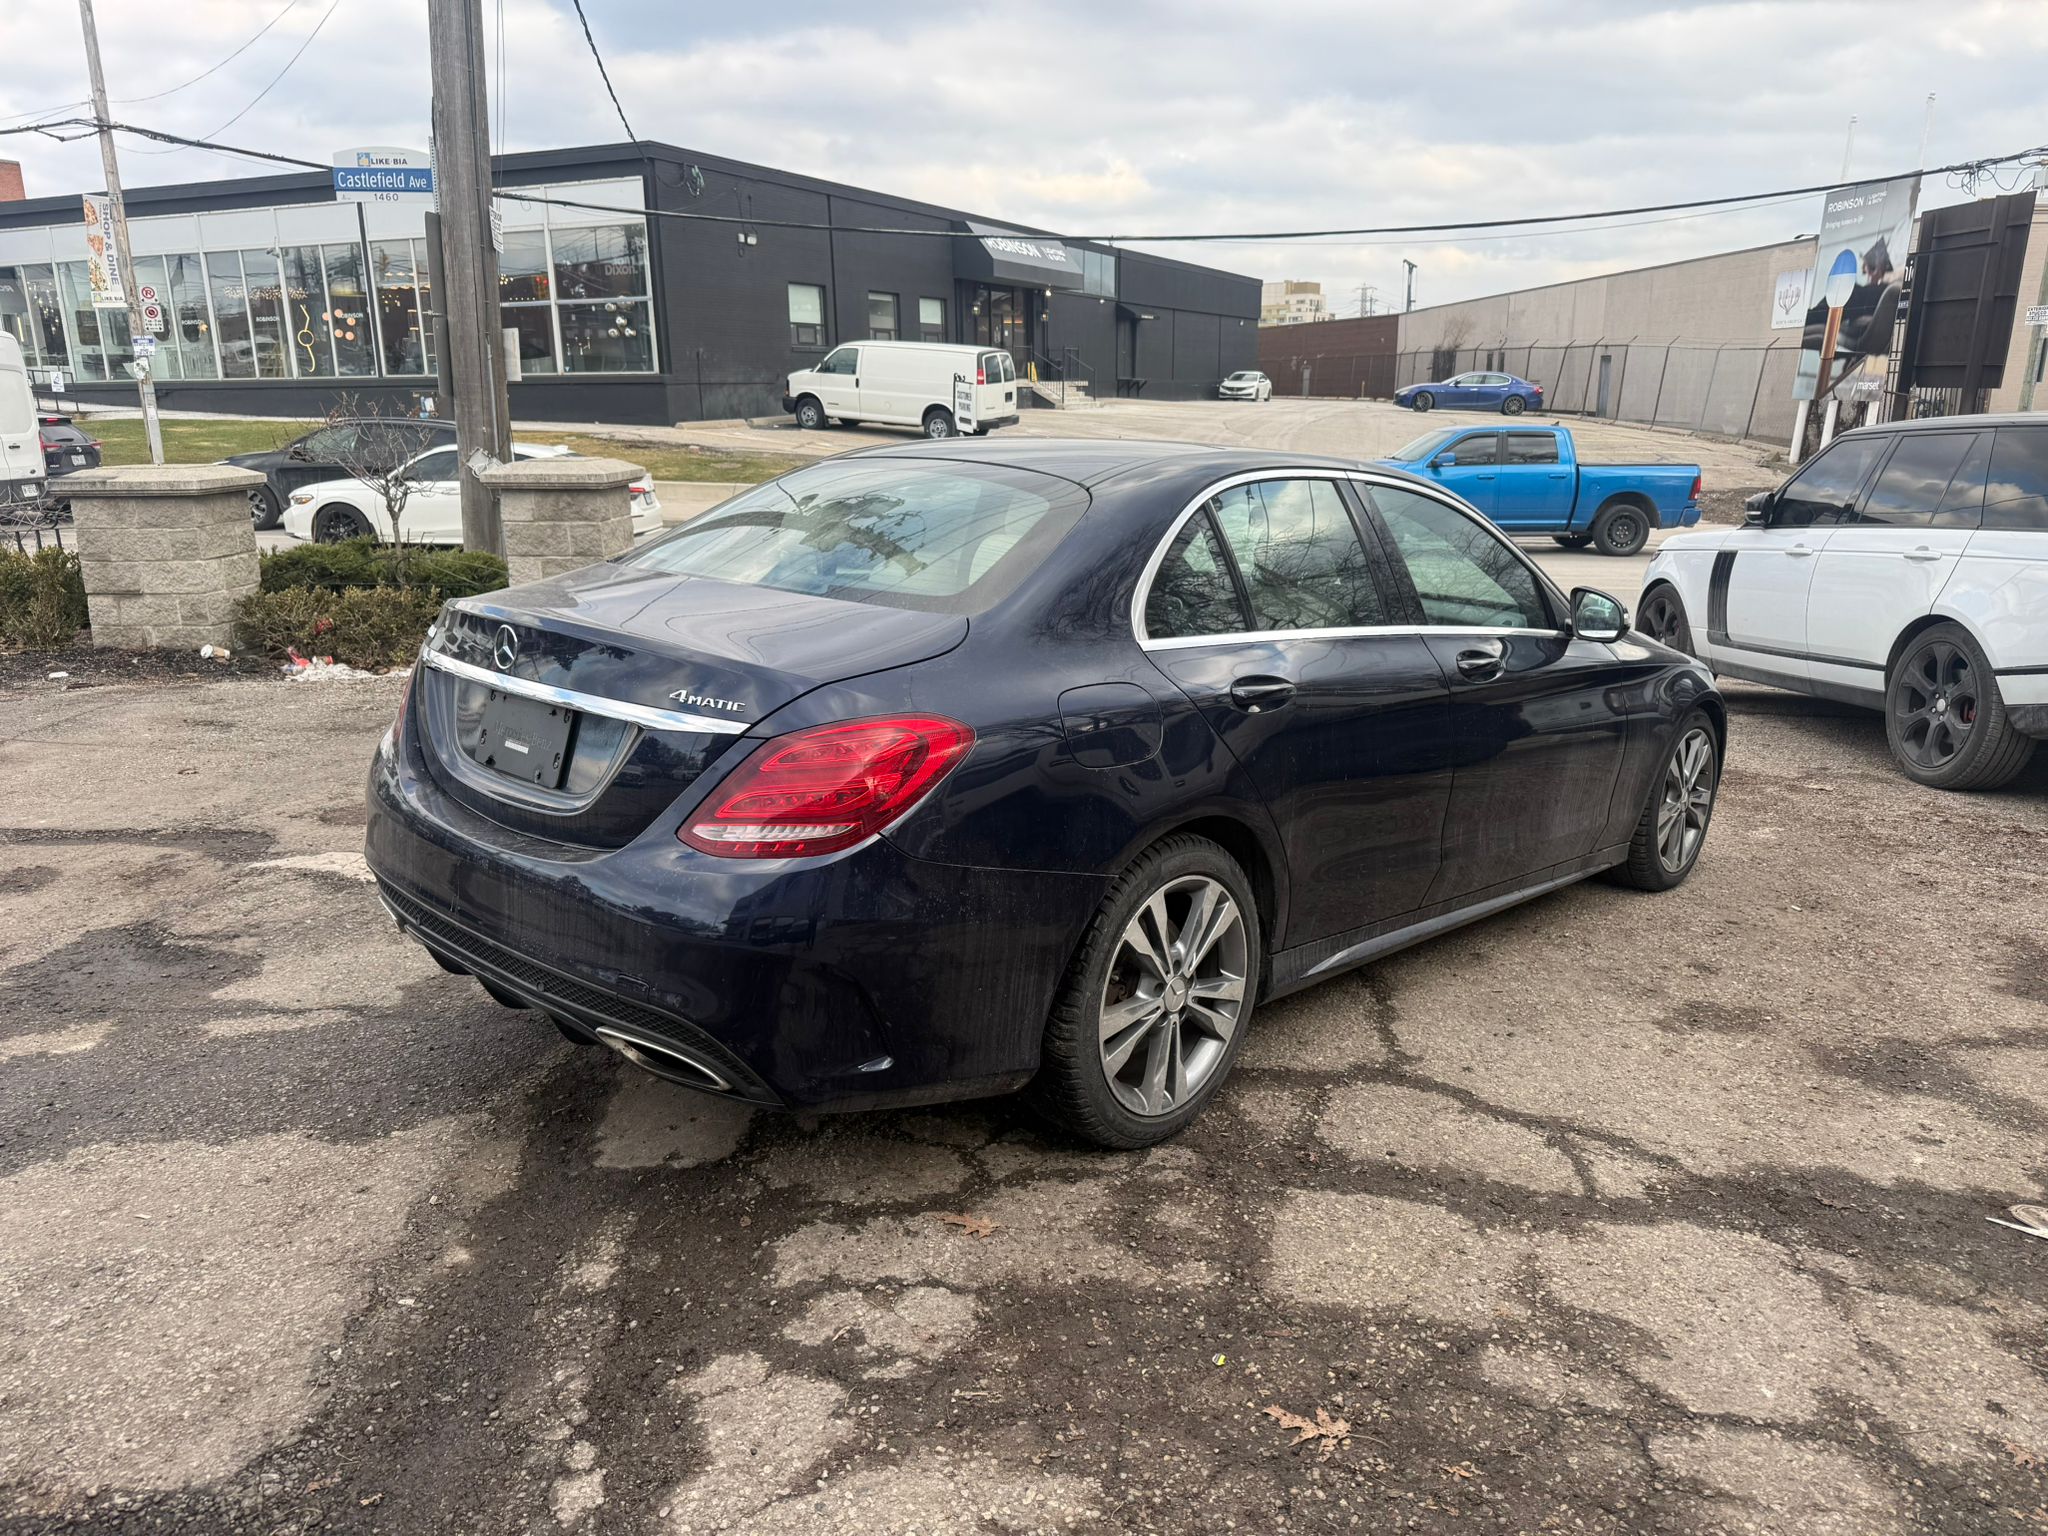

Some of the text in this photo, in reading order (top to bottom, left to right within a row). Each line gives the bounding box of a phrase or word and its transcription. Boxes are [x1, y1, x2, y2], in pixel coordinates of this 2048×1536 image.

[337, 171, 427, 188] Castlefield Ave
[374, 193, 399, 201] 1460
[1828, 196, 1865, 213] ROBINSON
[103, 203, 119, 286] SHOP & DINE
[984, 237, 1042, 259] ROBINSON
[1856, 381, 1880, 390] marset
[669, 689, 746, 712] 4MATIC
